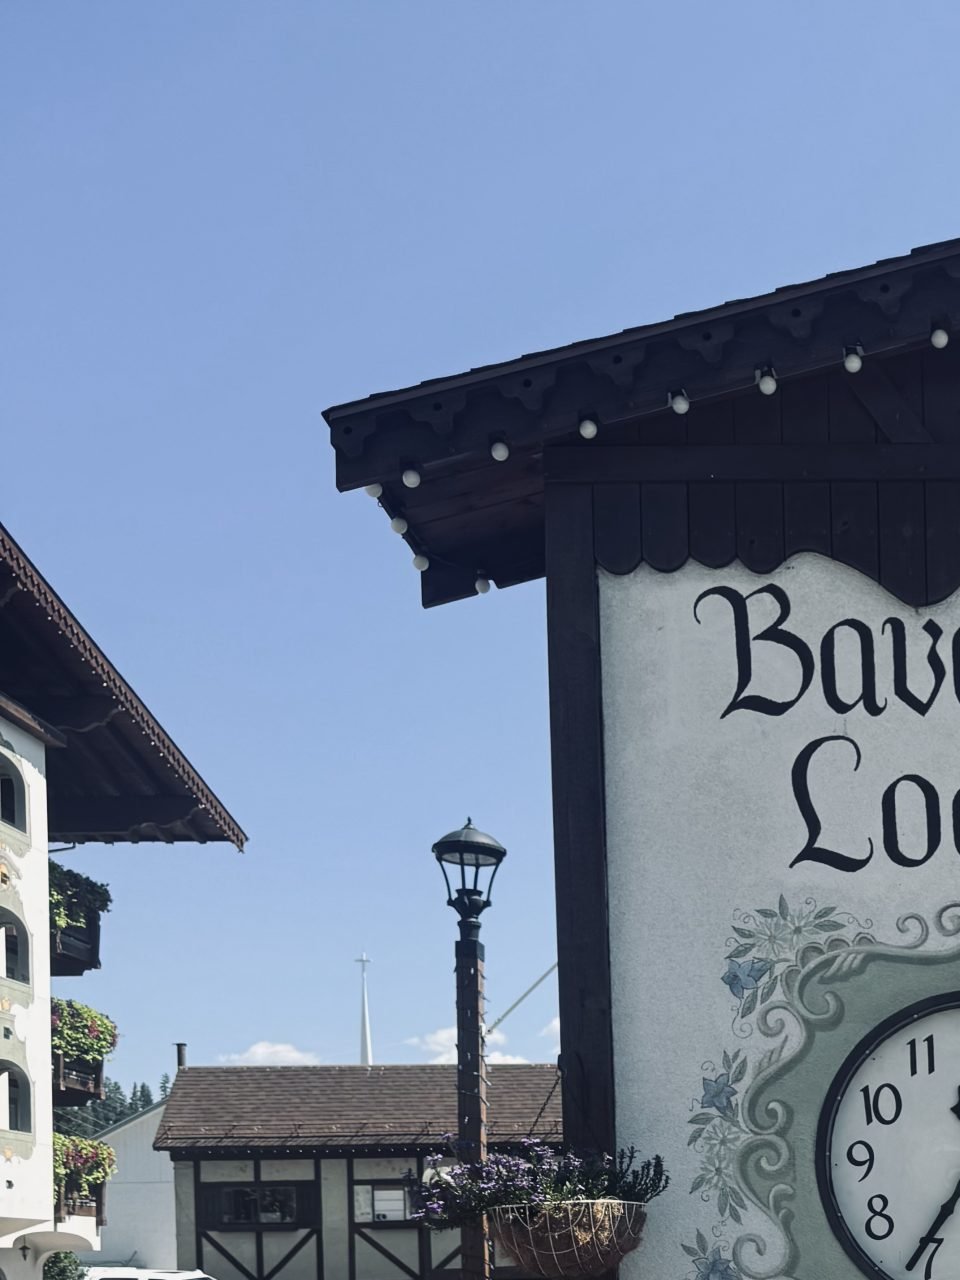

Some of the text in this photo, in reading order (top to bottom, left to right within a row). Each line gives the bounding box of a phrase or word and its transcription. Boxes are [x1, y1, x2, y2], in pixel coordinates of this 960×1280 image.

[906, 1034, 935, 1077] 11
[859, 1082, 903, 1126] 10
[846, 1139, 875, 1183] 9
[864, 1193, 895, 1241] 8
